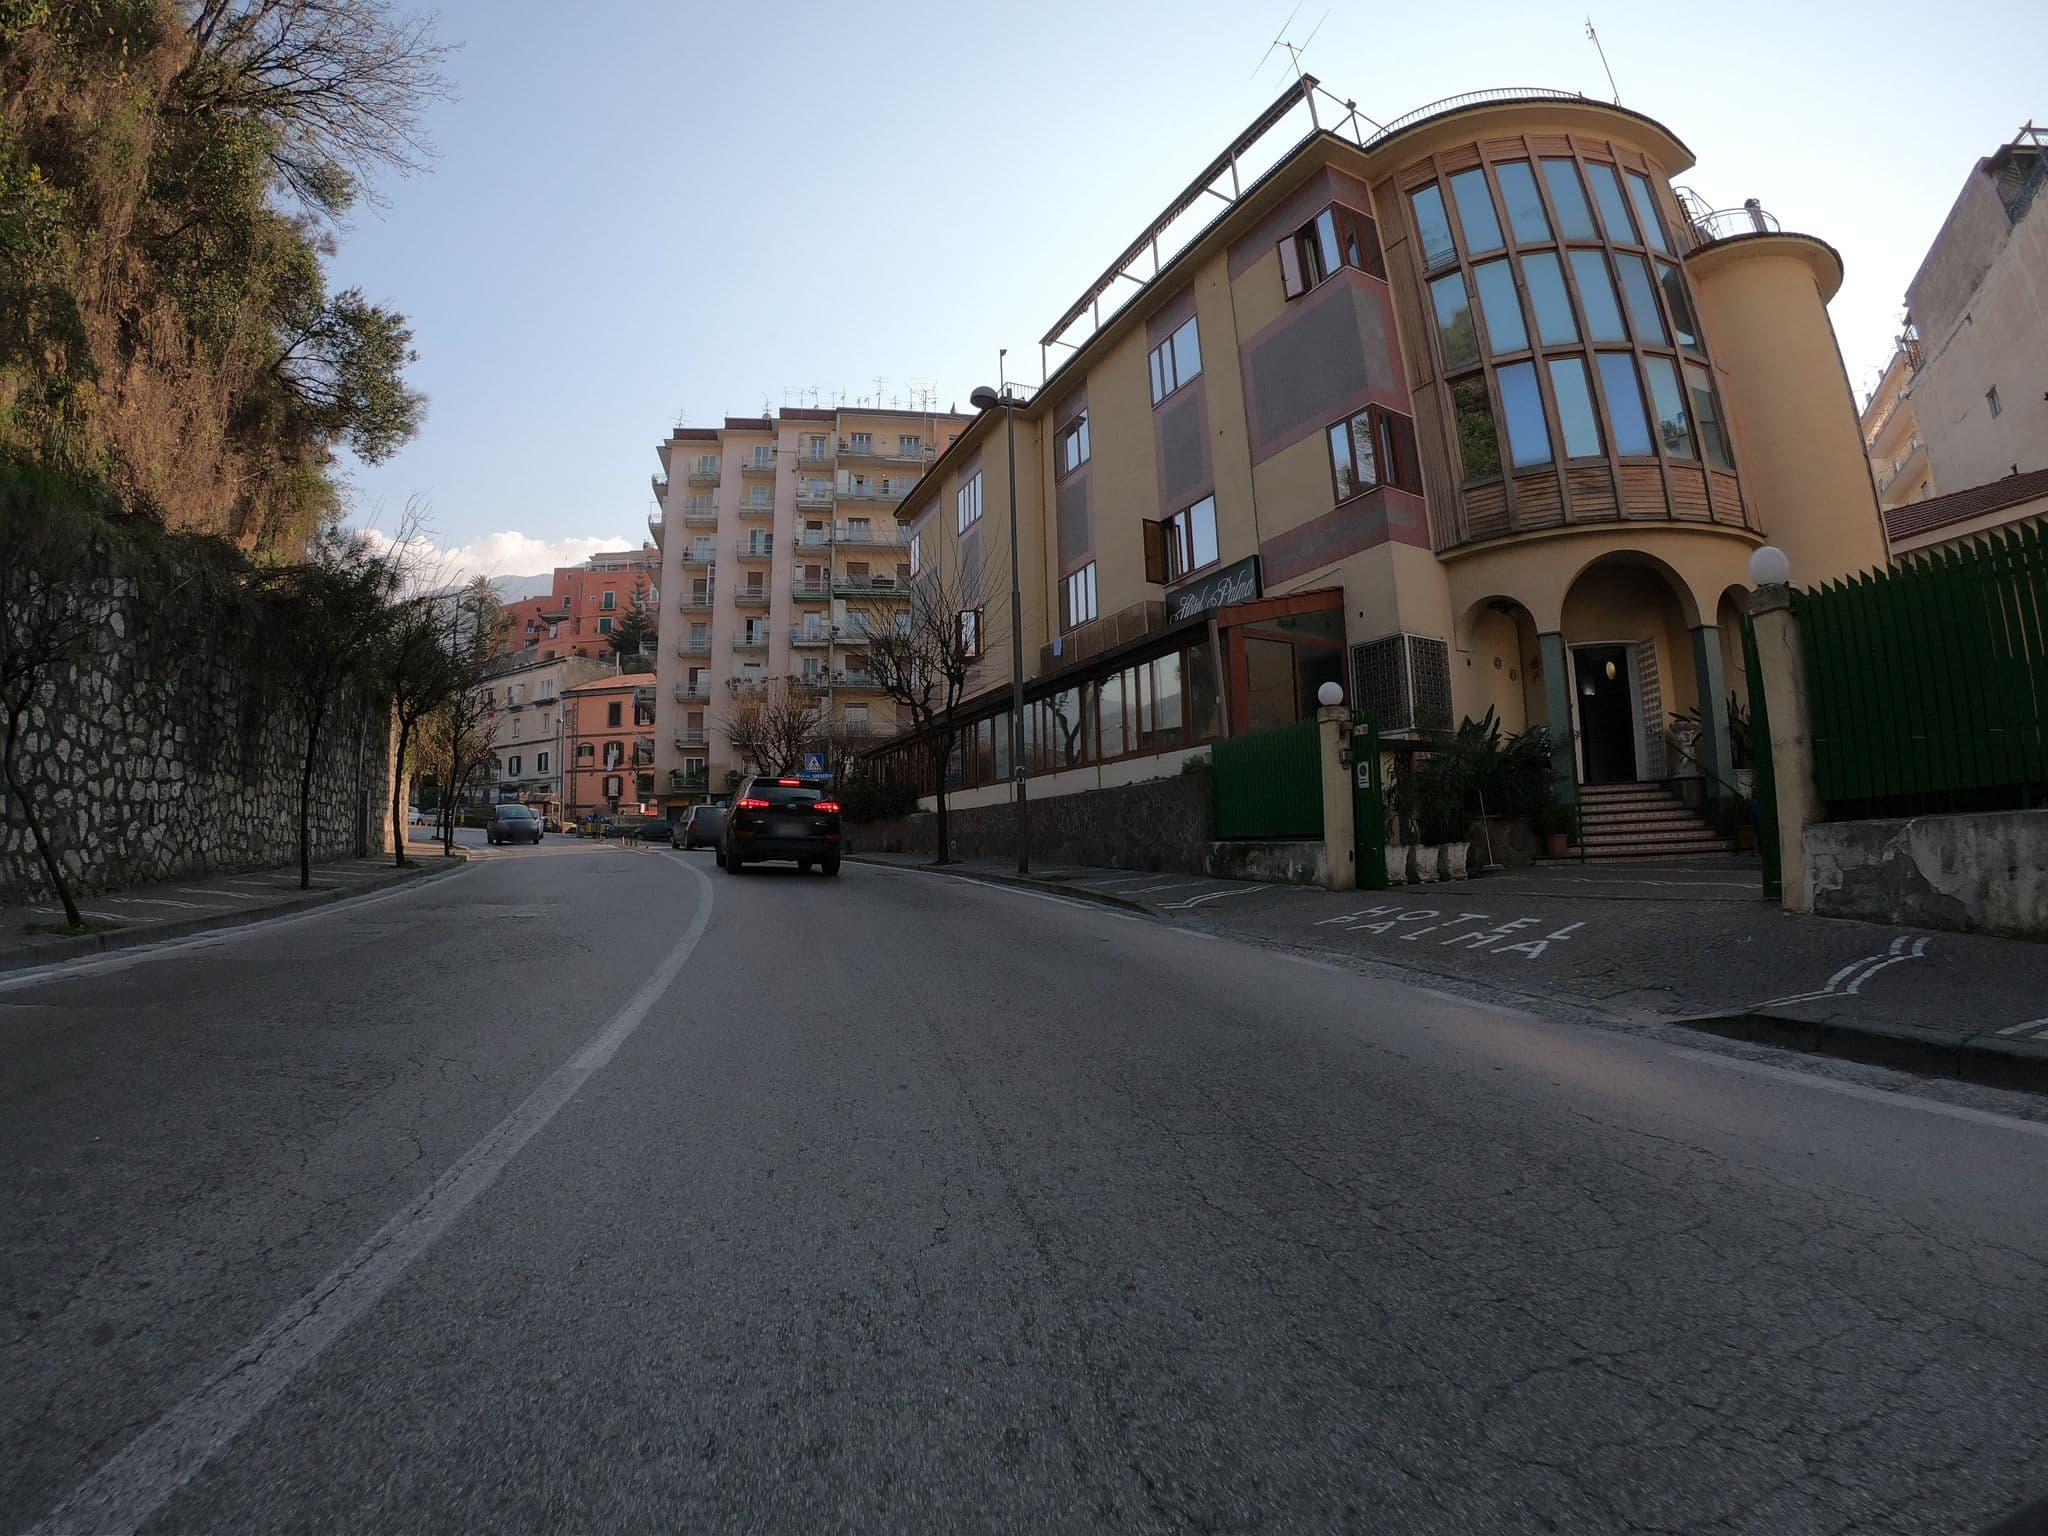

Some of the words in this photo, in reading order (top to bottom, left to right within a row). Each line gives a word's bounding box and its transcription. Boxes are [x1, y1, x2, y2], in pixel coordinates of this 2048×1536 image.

[1170, 586, 1208, 624] Hotel
[1207, 569, 1254, 607] Palma
[1313, 916, 1550, 959] PALMA
[1353, 906, 1587, 940] HOTEL
